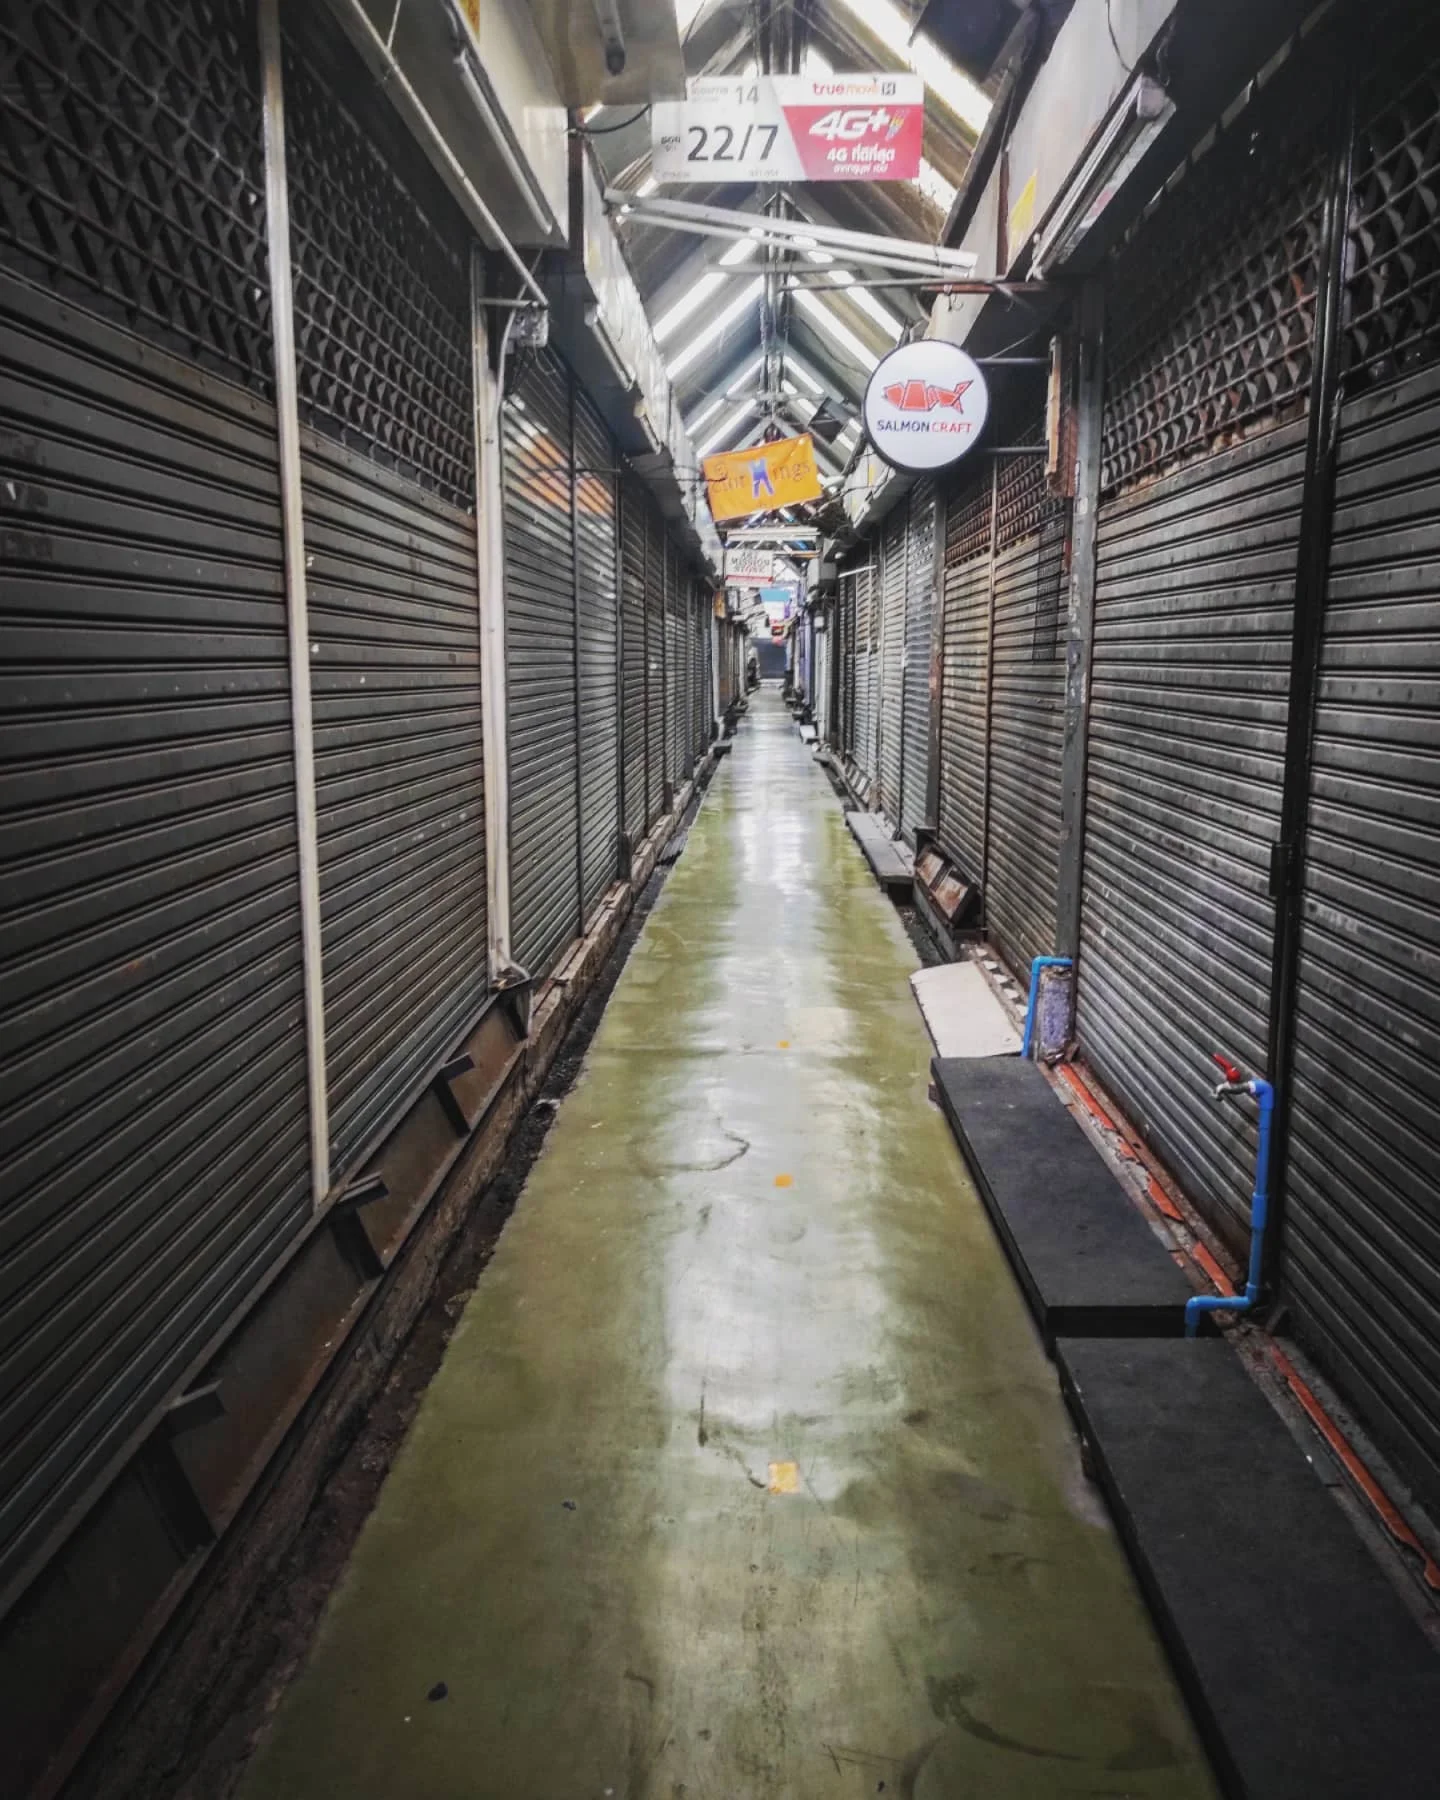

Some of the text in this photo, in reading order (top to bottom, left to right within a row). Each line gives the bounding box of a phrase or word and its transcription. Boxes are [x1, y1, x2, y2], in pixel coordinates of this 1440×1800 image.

[736, 85, 760, 104] 14
[809, 107, 890, 141] 4G+
[687, 124, 778, 162] 22/7
[827, 147, 848, 162] 4G
